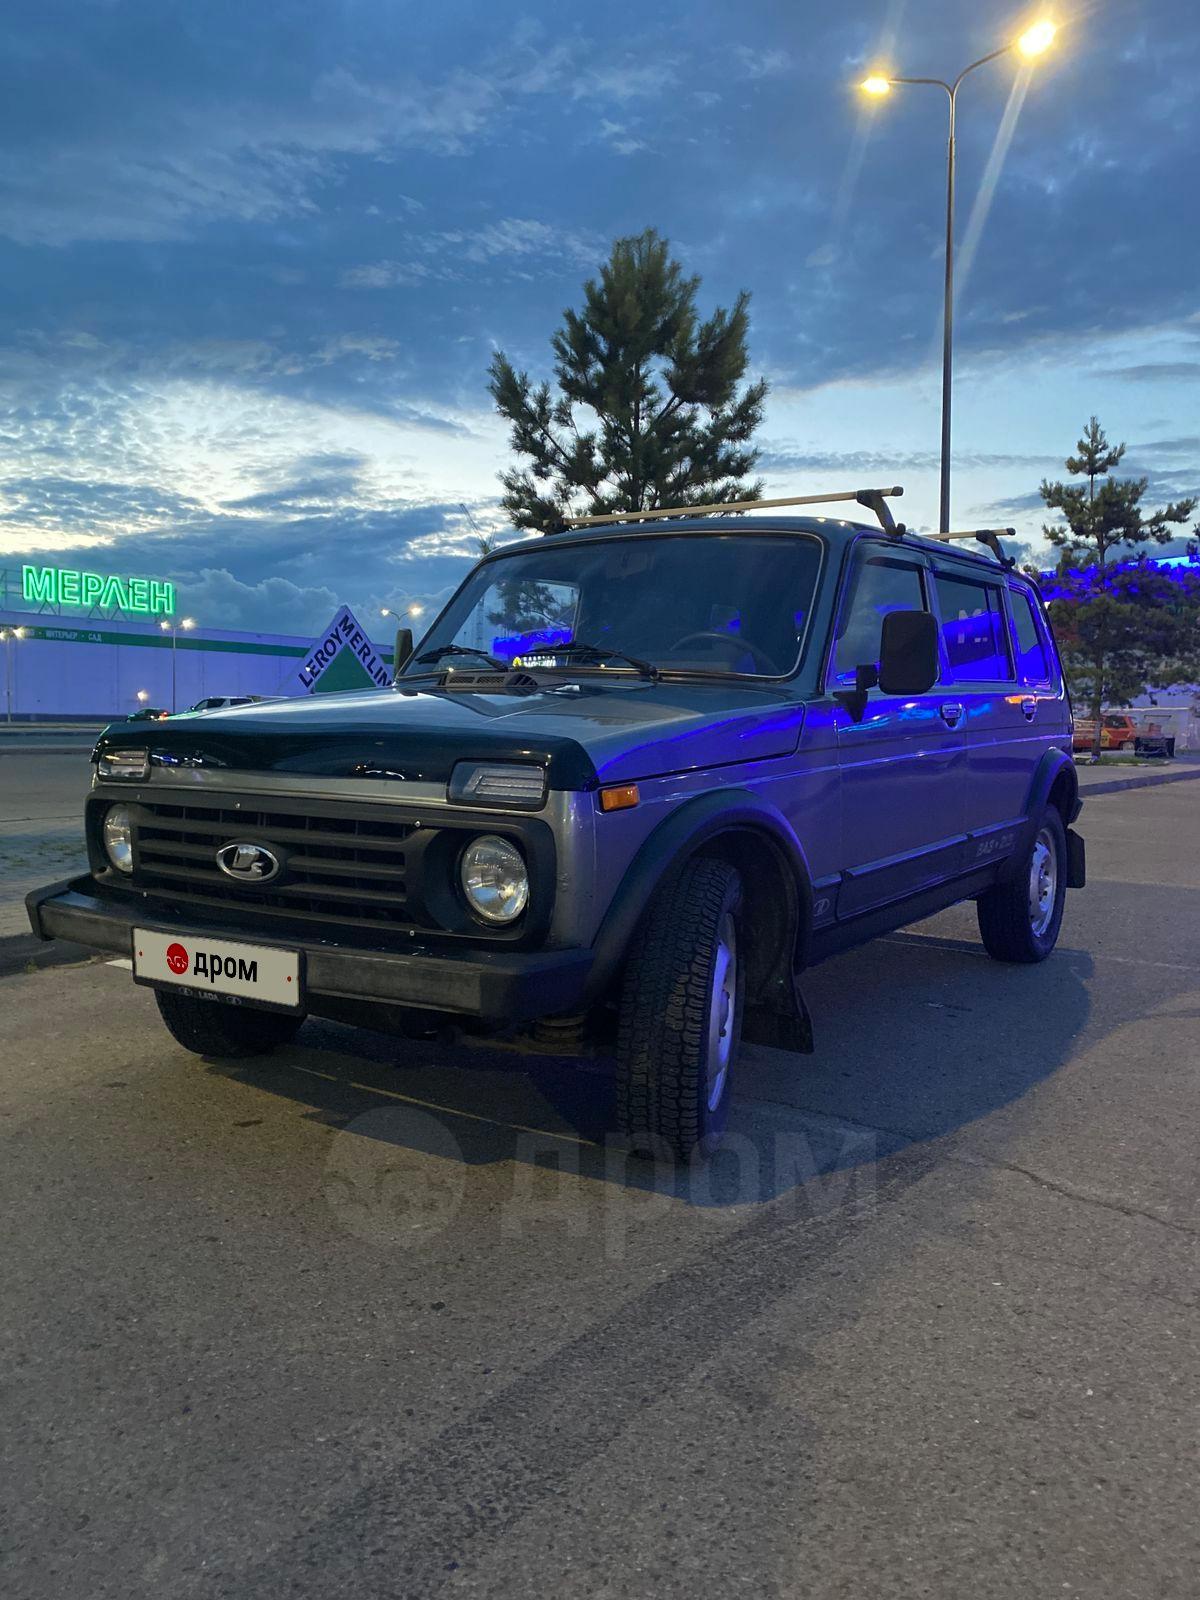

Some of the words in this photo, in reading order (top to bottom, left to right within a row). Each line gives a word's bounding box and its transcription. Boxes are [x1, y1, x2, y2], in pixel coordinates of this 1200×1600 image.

[22, 565, 174, 614] МЕРЛЕН
[298, 627, 342, 688] LEROY
[338, 614, 392, 687] MERLIN
